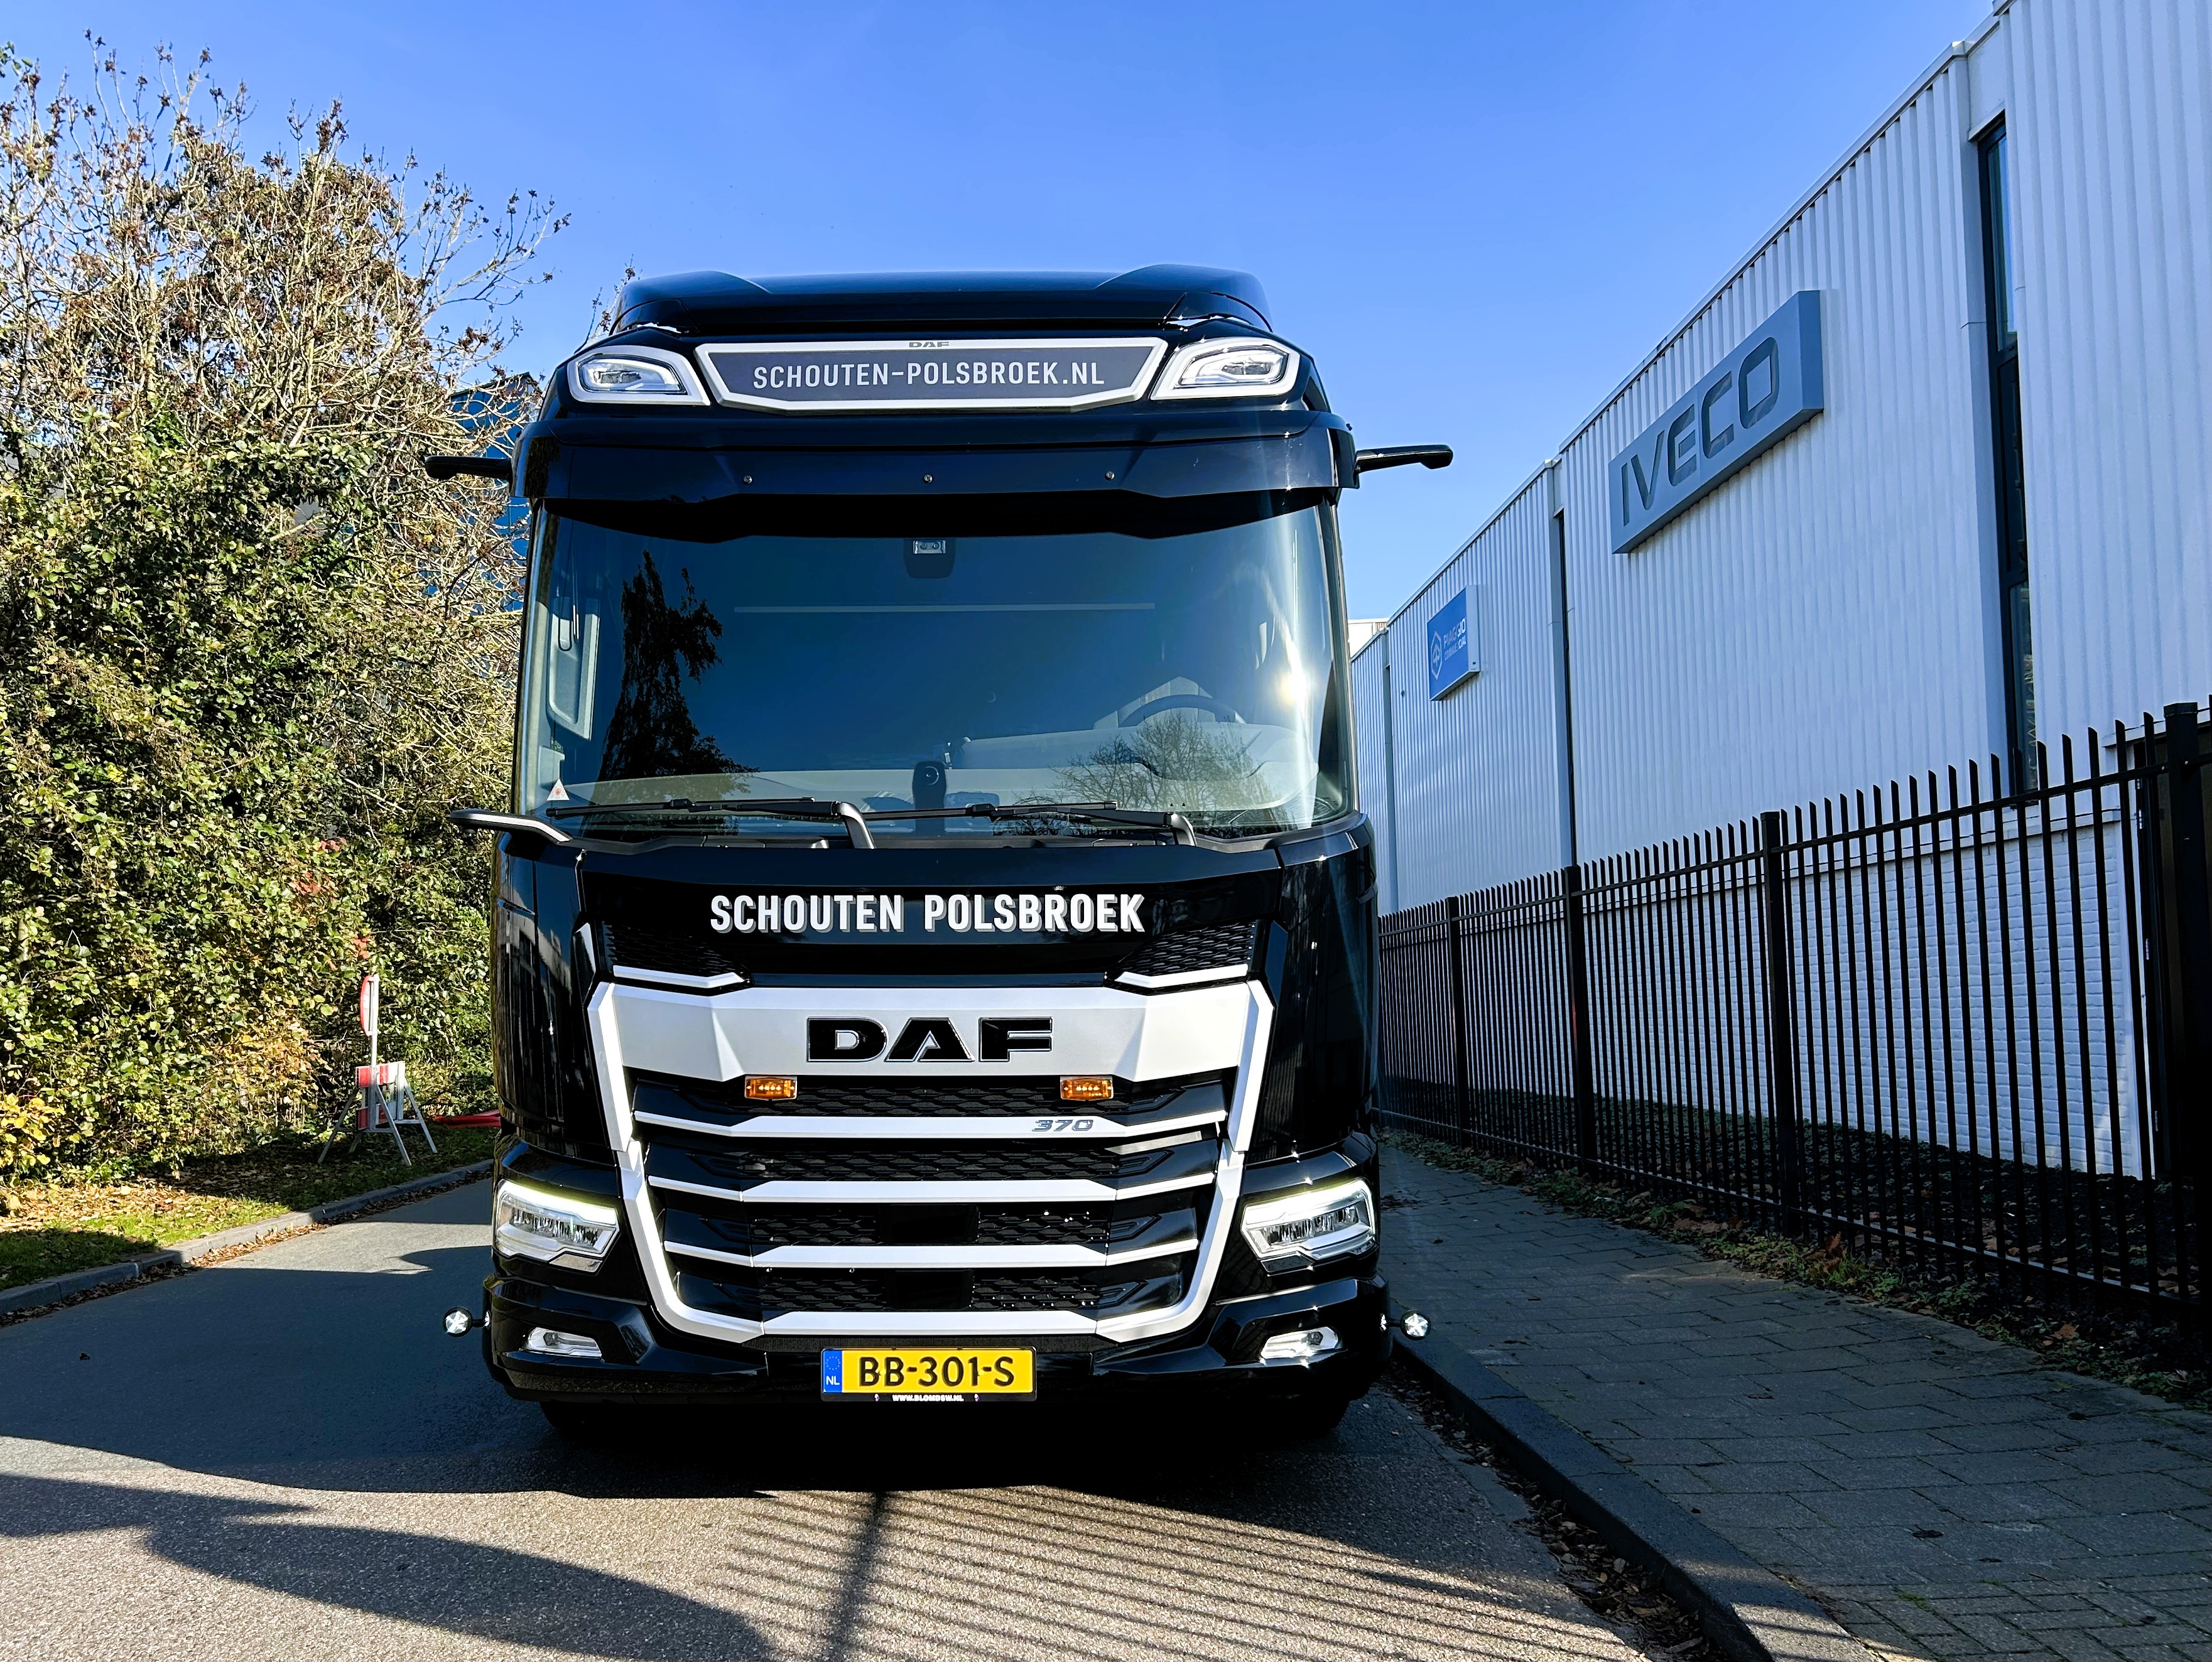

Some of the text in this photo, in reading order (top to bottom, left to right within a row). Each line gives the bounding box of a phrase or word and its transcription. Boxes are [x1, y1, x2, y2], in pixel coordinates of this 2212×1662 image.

[752, 362, 1105, 389] SCHOUTEN-POLSBROEK.NL
[1621, 337, 1780, 527] IVECO
[710, 893, 1146, 934] SCHOUTEN POLSBROEK
[806, 1016, 1053, 1062] DAF
[1032, 1120, 1093, 1131] 370
[826, 1356, 1014, 1386] NL BB-301-S
